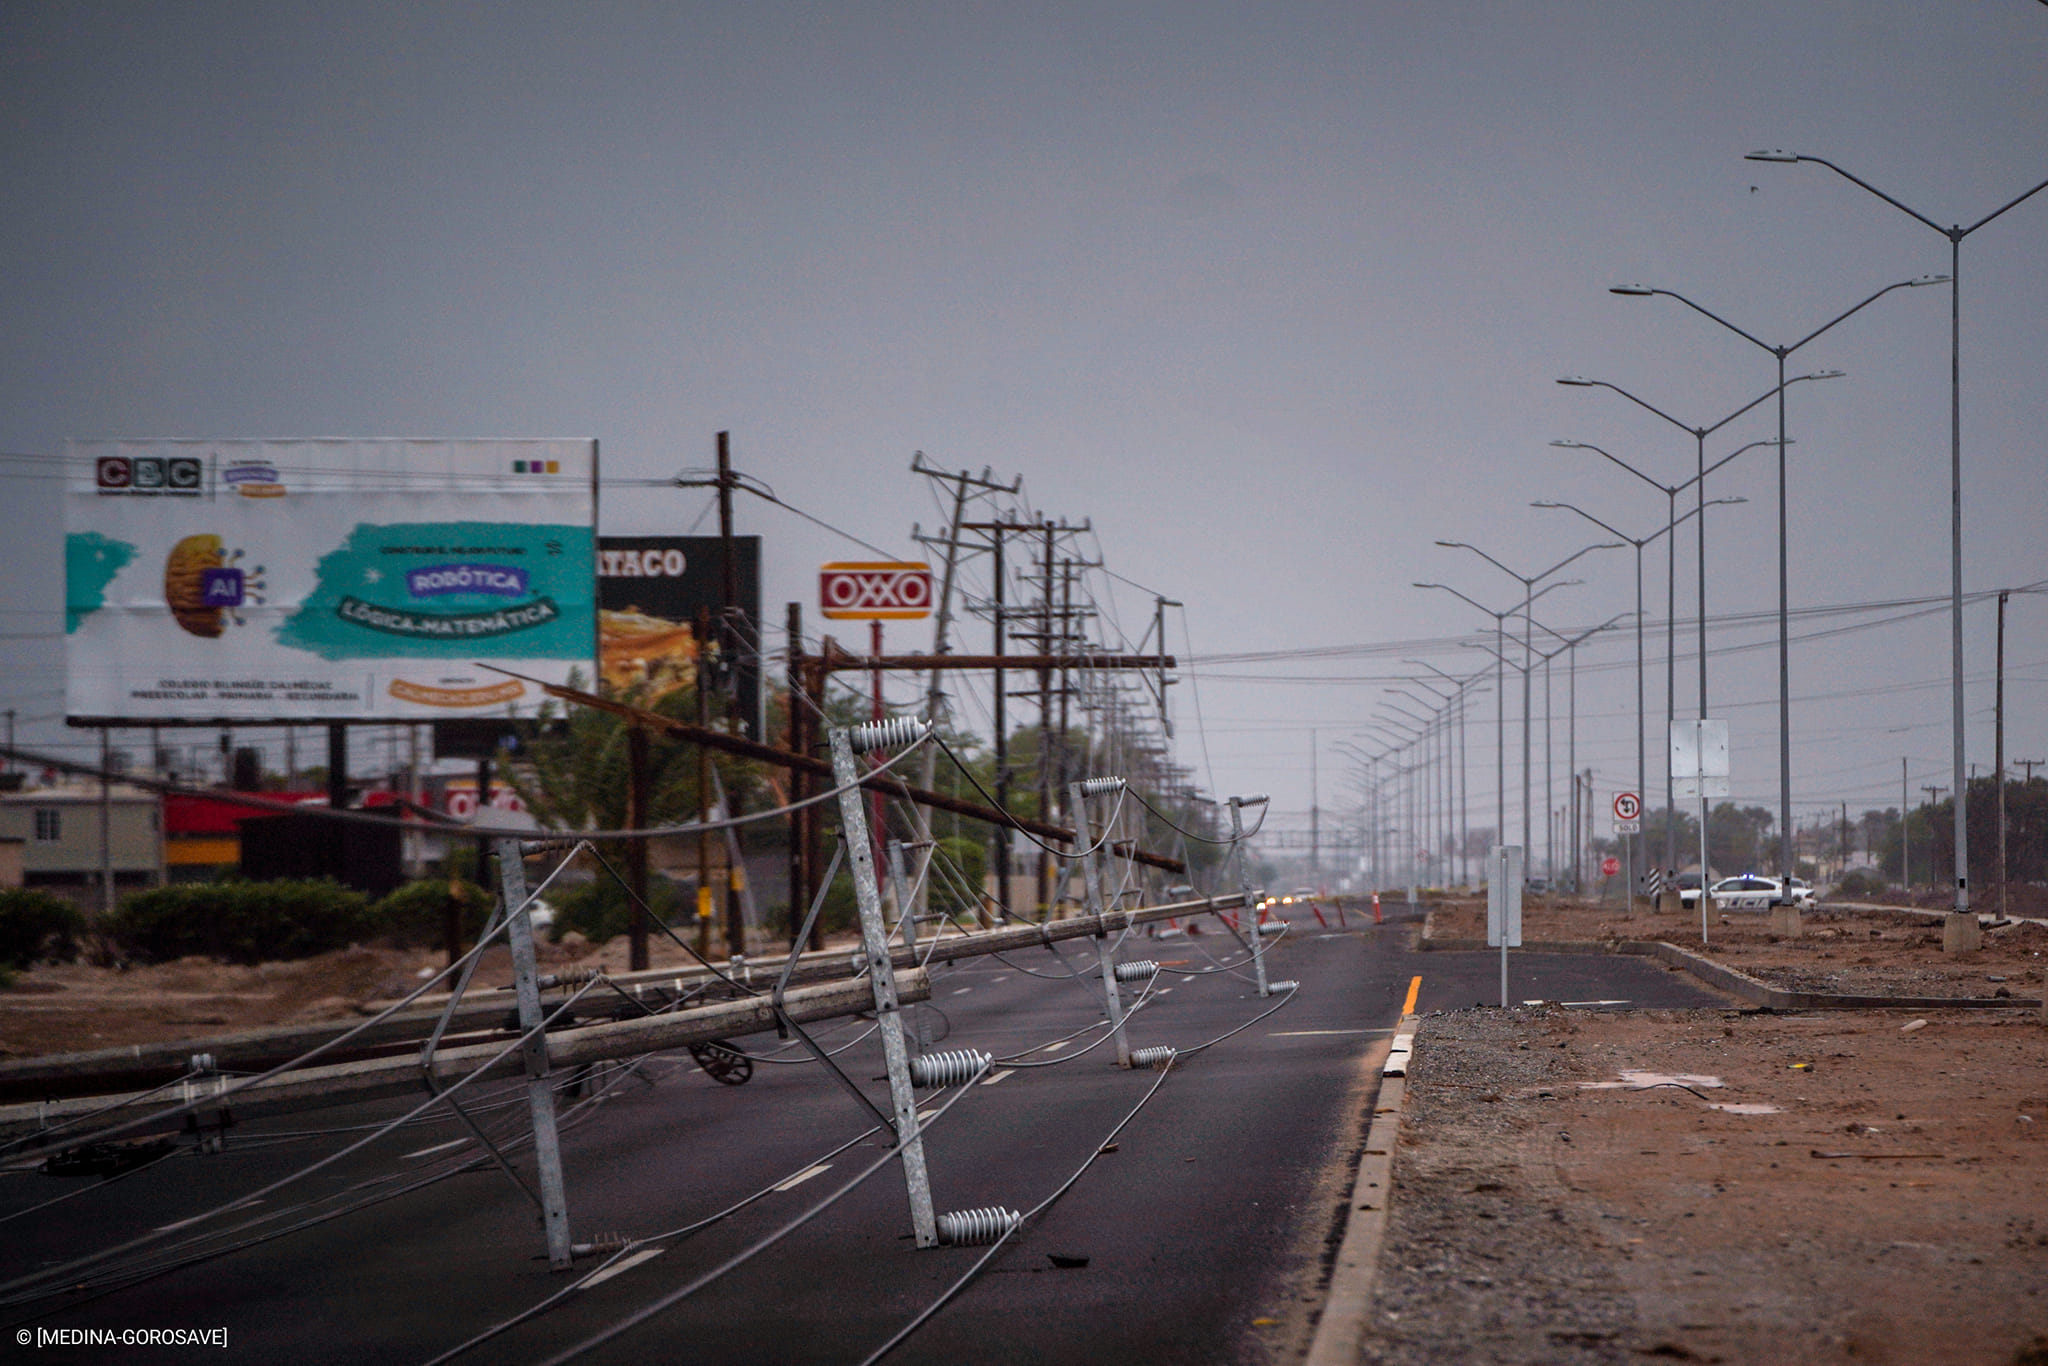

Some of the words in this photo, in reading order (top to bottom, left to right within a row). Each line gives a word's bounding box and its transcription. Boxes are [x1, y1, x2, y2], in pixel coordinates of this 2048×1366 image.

[99, 458, 201, 487] CBC
[208, 578, 237, 597] AI
[413, 565, 521, 591] ROBÓTICA
[830, 574, 928, 606] OXXO
